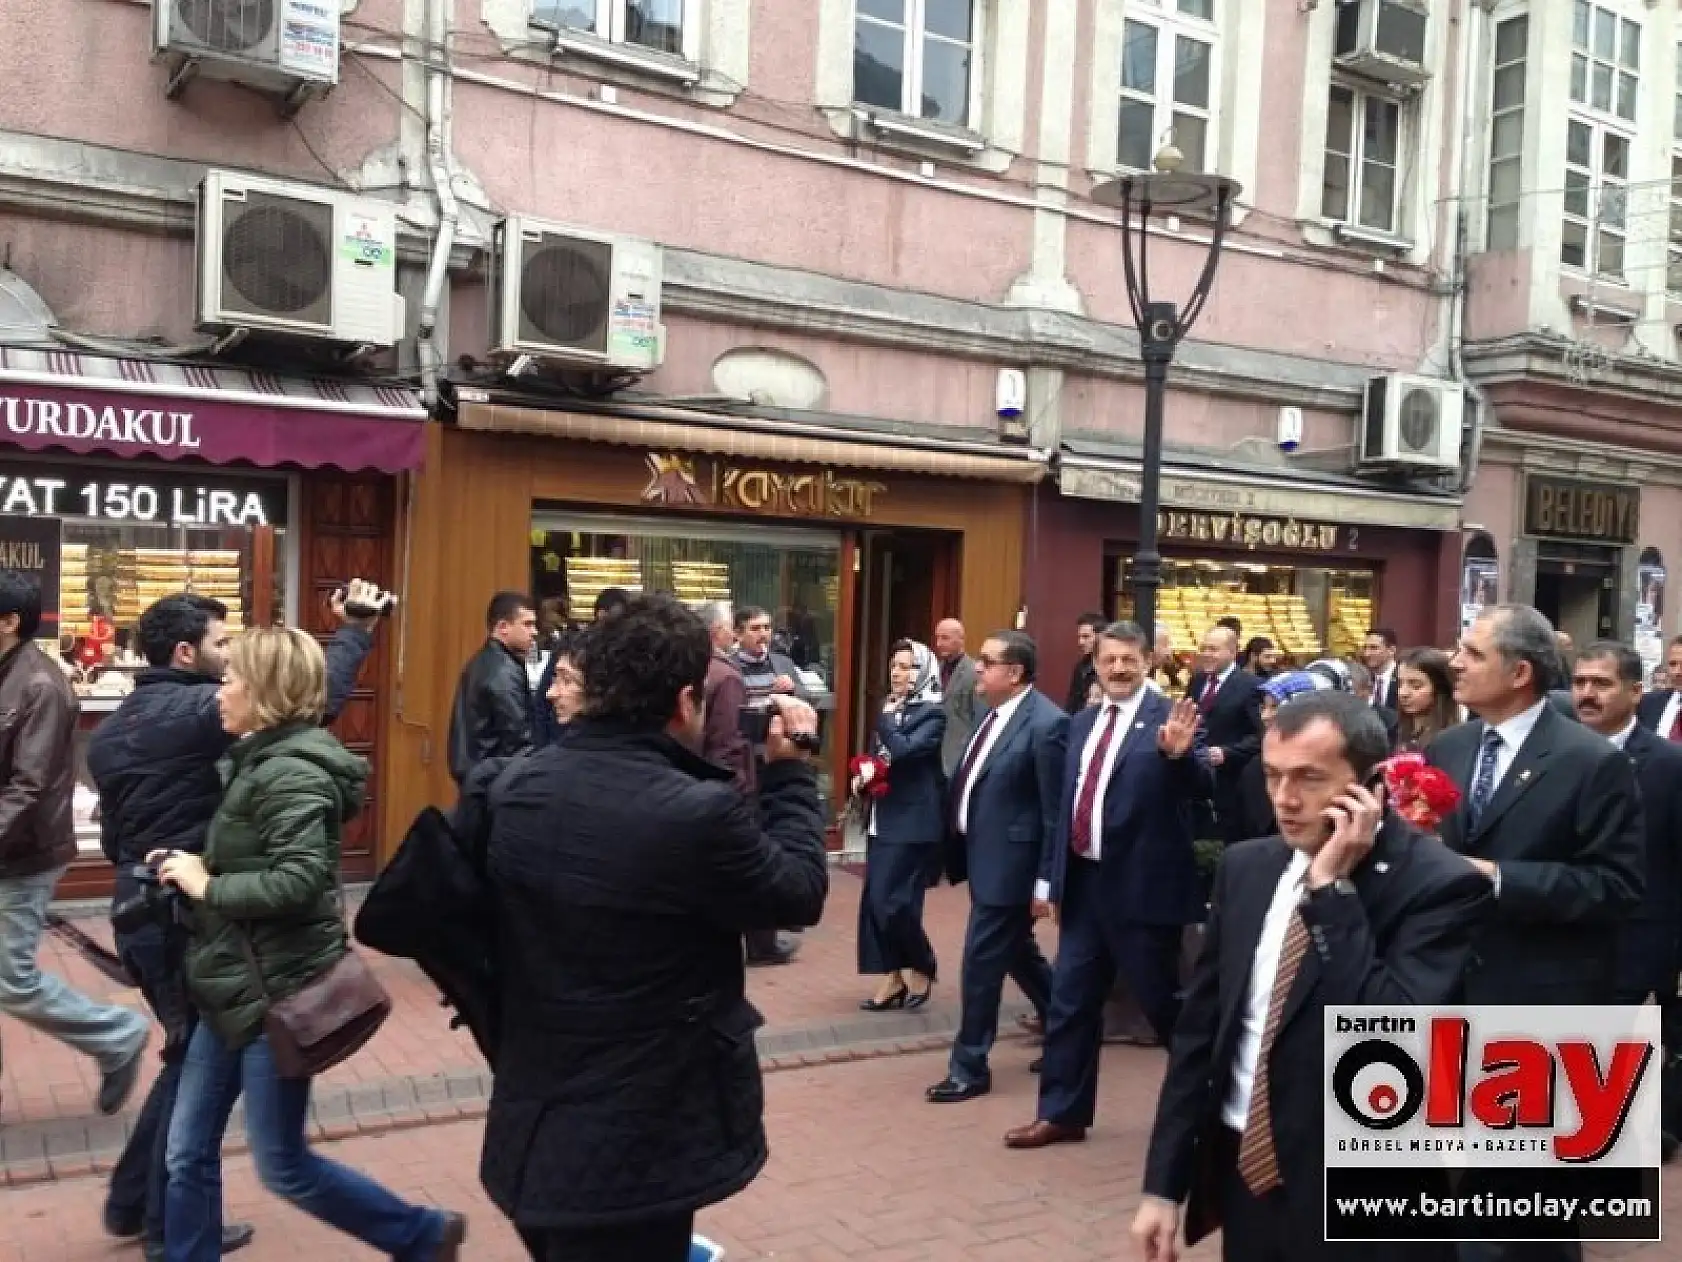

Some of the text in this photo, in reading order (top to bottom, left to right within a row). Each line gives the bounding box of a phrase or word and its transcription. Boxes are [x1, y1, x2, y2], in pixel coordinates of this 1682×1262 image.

[0, 397, 200, 447] URDAKUL
[80, 482, 159, 521] 150
[1347, 527, 1359, 550] 2
